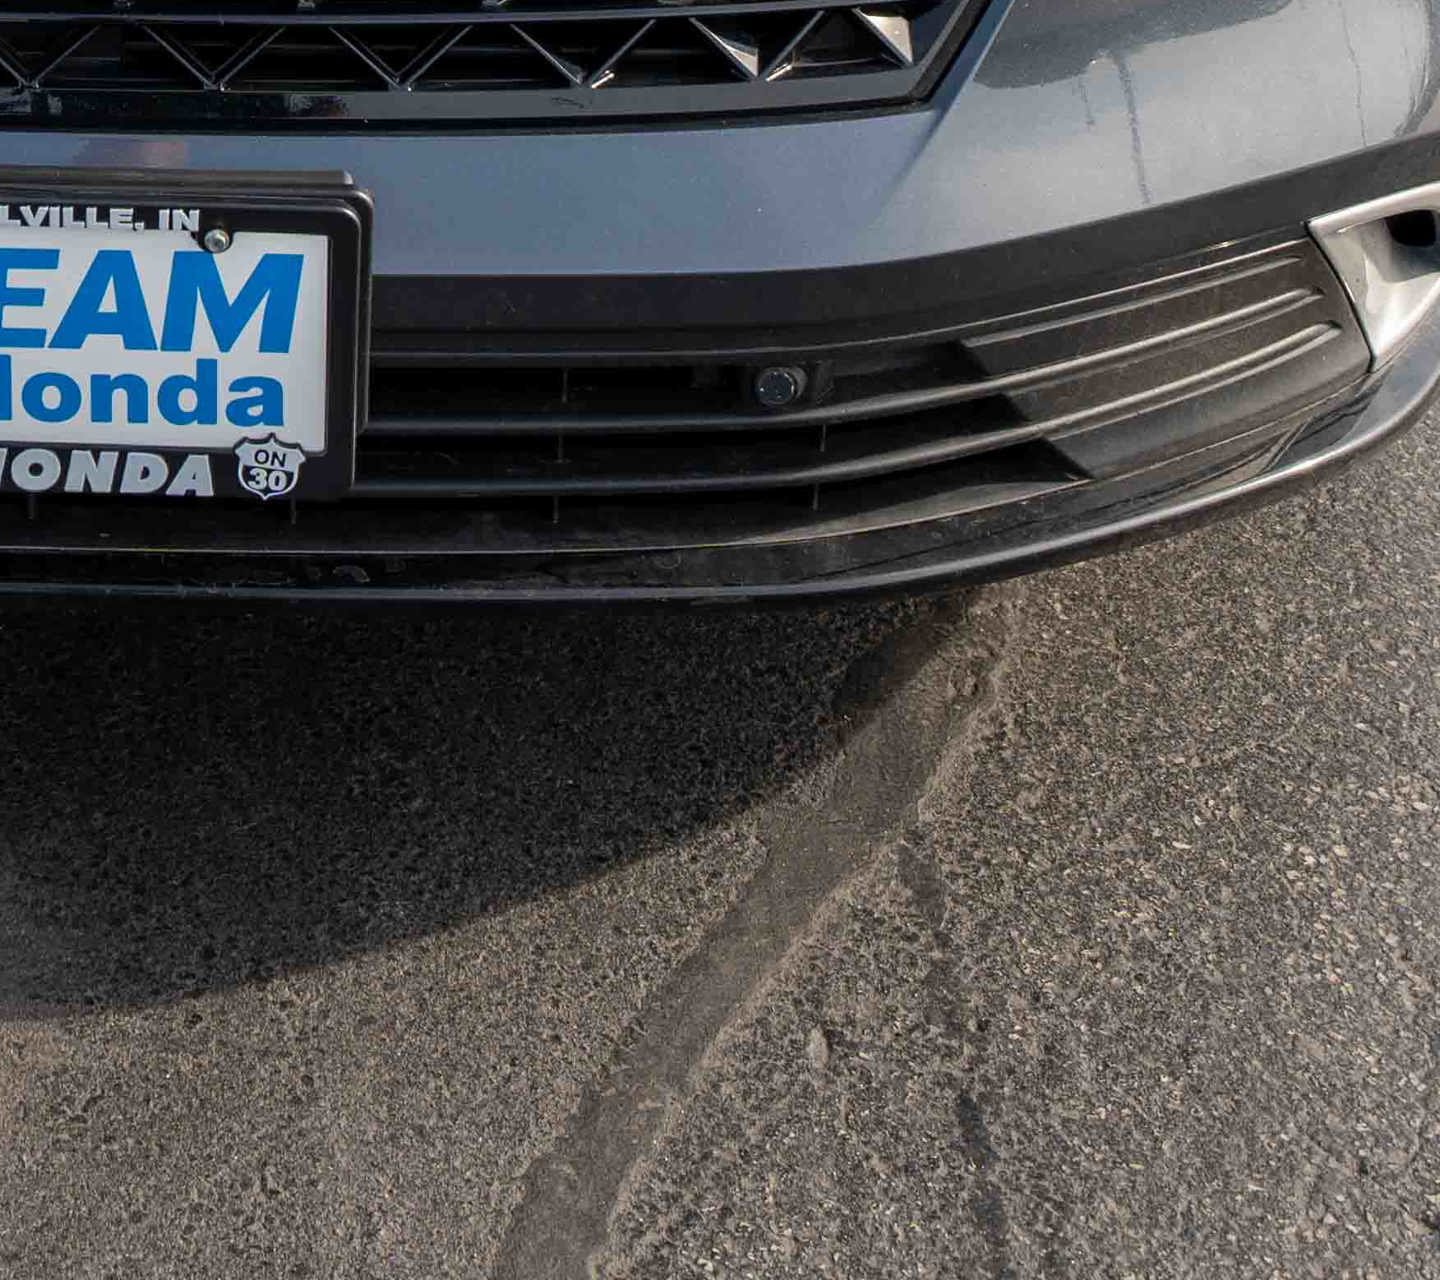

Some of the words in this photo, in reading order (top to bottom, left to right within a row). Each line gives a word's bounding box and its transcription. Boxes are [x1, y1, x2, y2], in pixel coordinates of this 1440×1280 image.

[158, 208, 200, 232] IN
[253, 448, 287, 468] ON
[247, 469, 288, 493] 30
